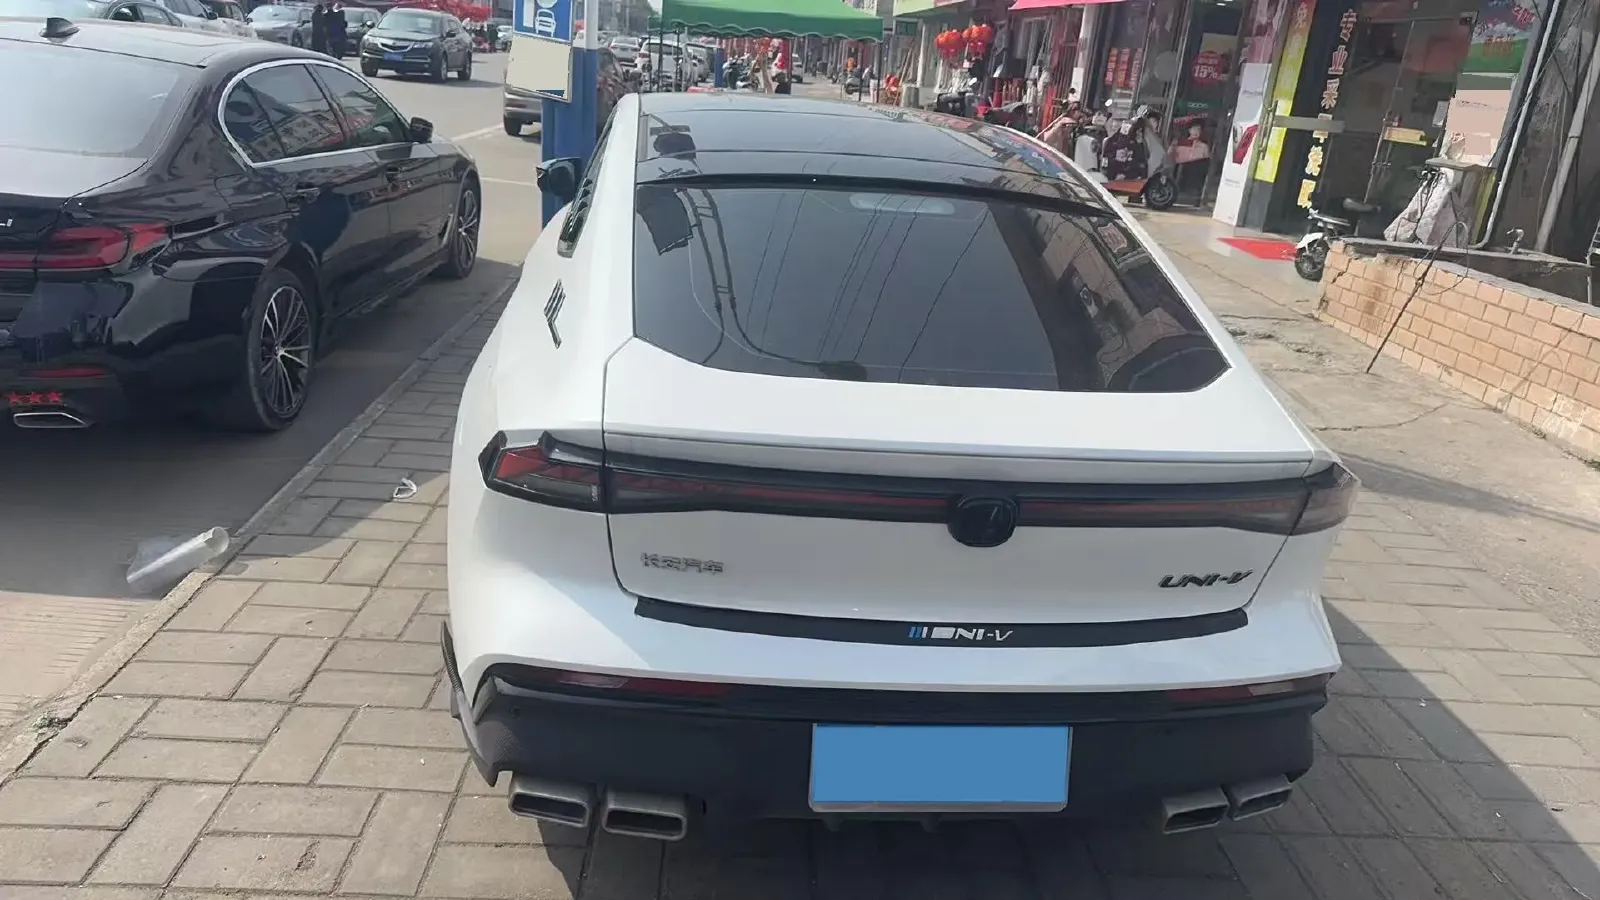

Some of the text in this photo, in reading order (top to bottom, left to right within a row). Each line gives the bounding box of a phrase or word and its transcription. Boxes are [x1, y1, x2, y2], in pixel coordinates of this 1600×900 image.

[640, 552, 724, 576] 长安汽车
[1158, 568, 1254, 588] UNI-V
